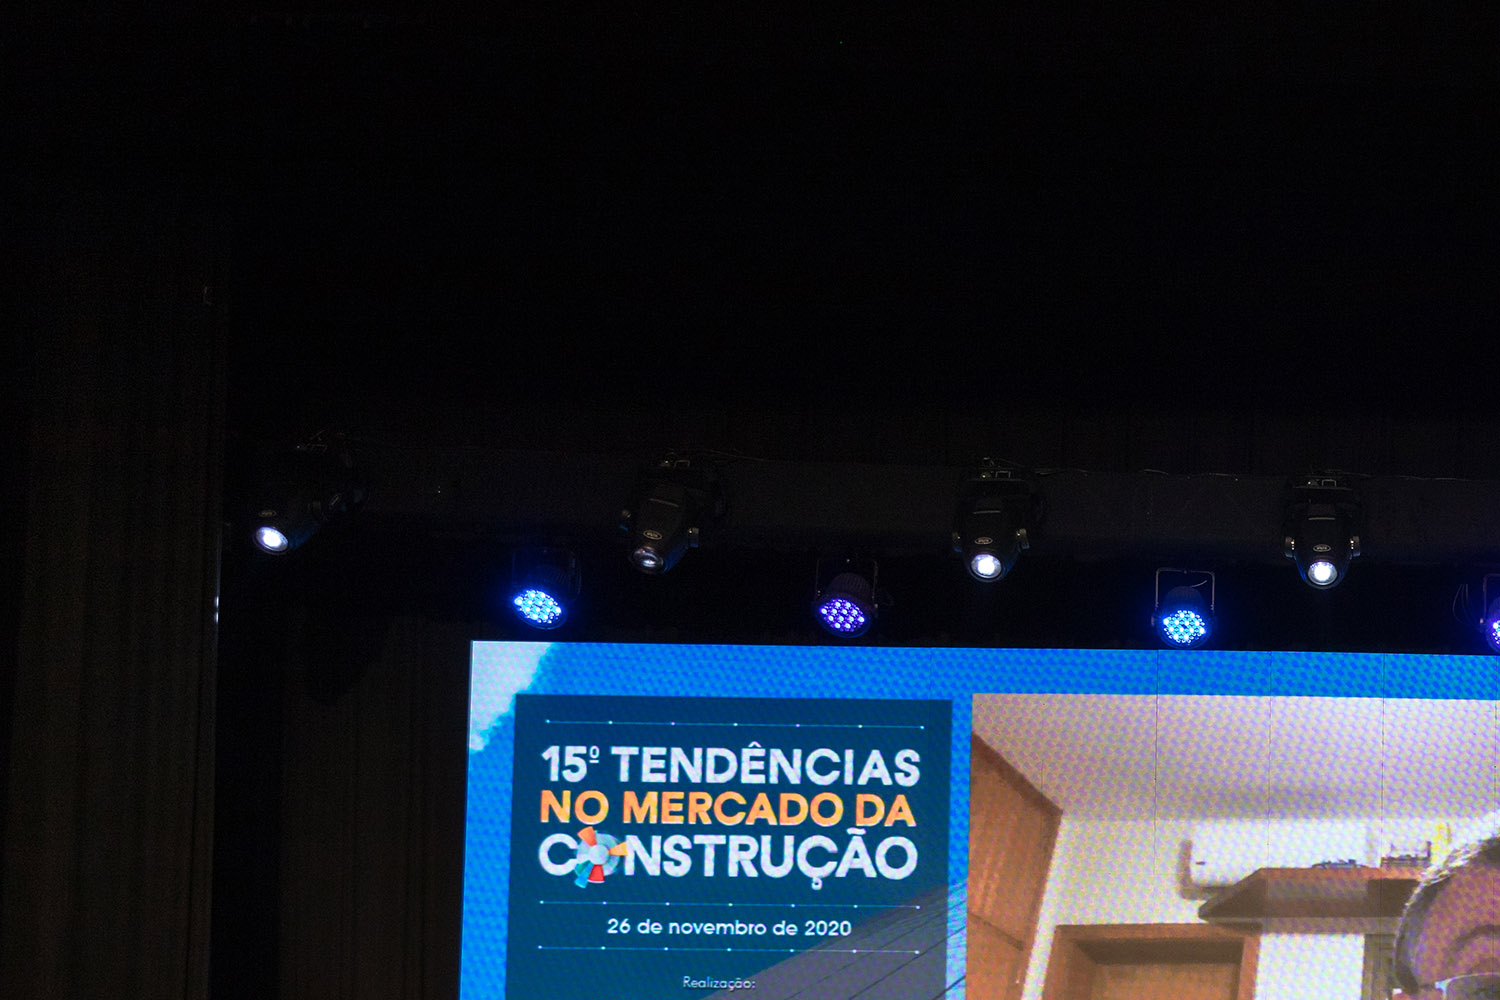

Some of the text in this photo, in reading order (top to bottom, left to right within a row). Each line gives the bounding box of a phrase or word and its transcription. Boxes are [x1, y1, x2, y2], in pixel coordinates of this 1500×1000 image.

[611, 741, 920, 786] TENDÊNCIAS
[540, 790, 917, 827] NO MERCADO DA
[538, 827, 918, 890] CONSTRUÇÃO
[607, 918, 852, 936] 26 de novembro de 2020
[683, 976, 756, 992] Realização:
